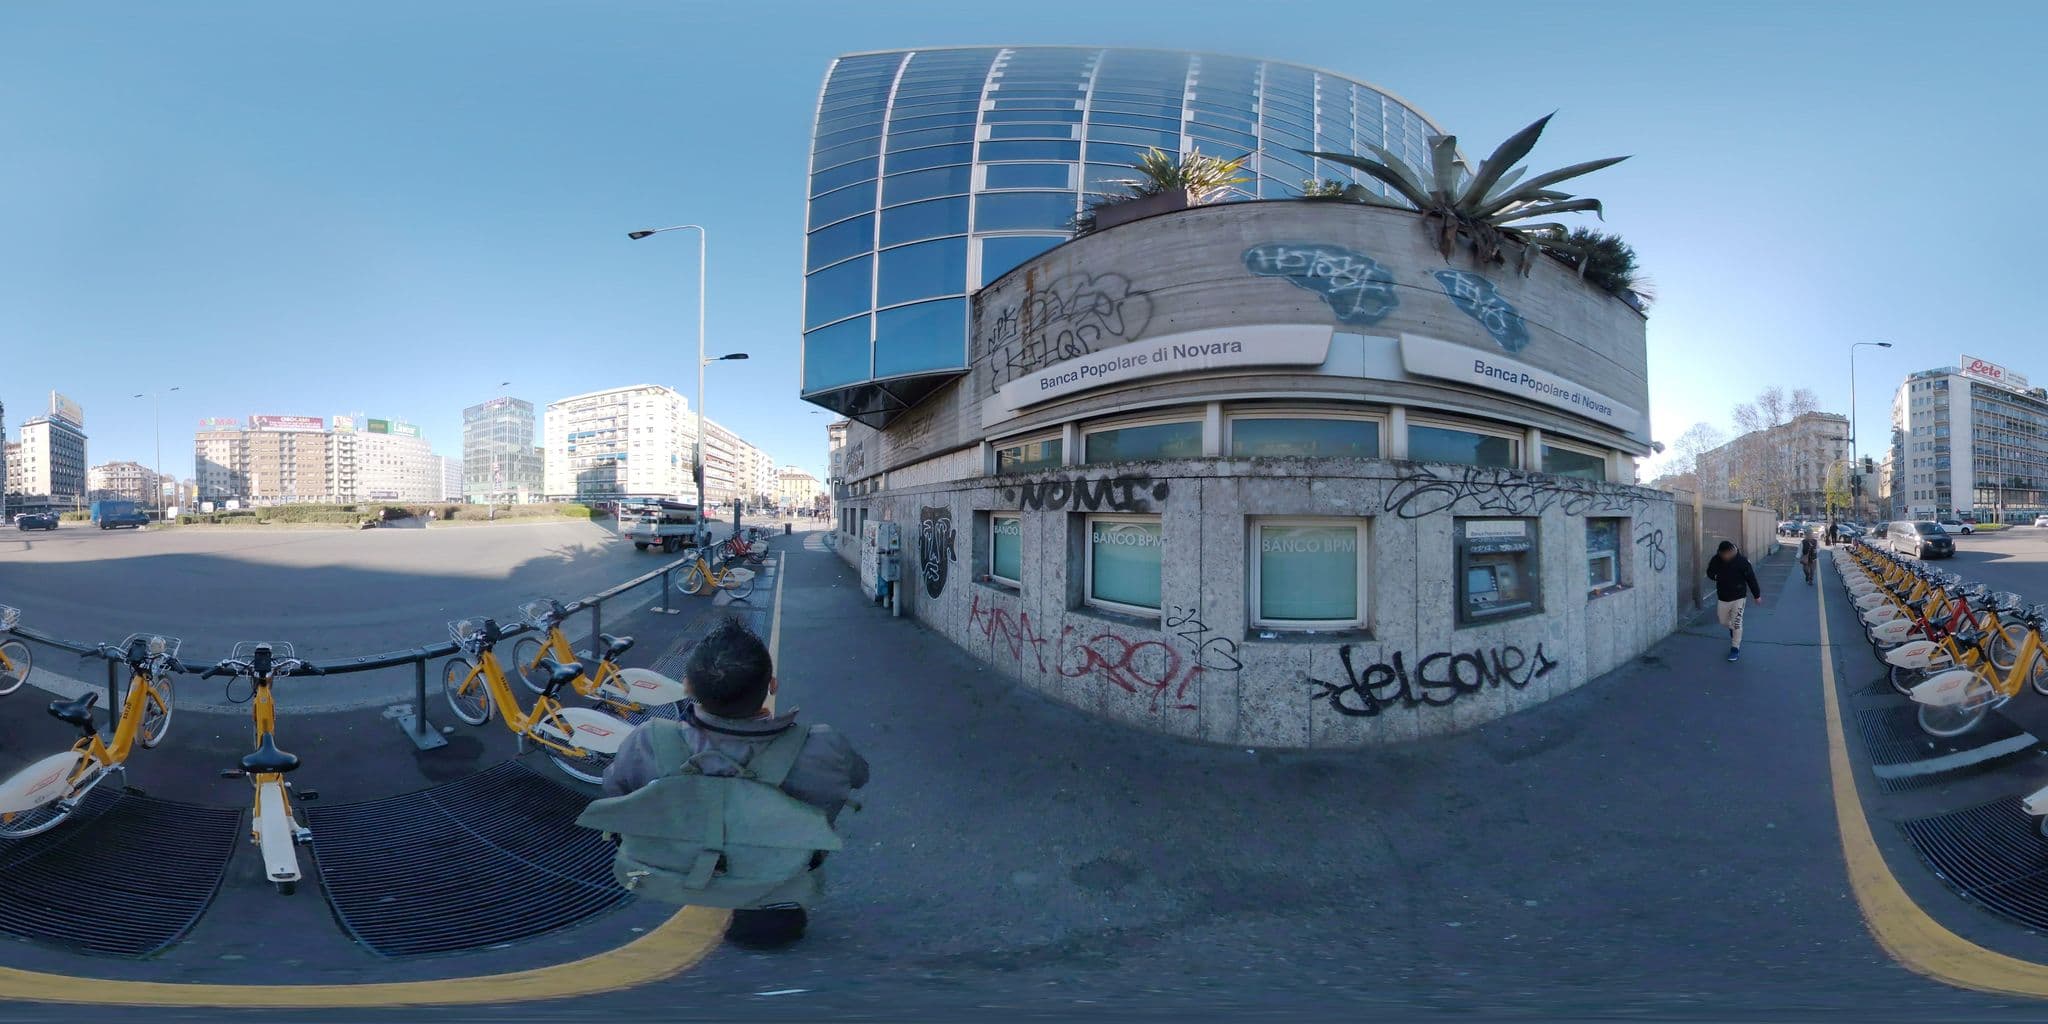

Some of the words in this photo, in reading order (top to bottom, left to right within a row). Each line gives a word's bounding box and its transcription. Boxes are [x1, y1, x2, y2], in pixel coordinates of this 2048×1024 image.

[1040, 370, 1079, 391] Banca
[1080, 353, 1148, 380] Popolare
[1152, 345, 1168, 362] di
[1172, 338, 1243, 359] Novara
[1966, 360, 2001, 378] Lete
[1474, 359, 1518, 384] Banca
[1520, 373, 1569, 400] Popolare
[1571, 391, 1581, 404] di
[1582, 396, 1612, 416] Novara
[994, 524, 1019, 536] BANCO
[1093, 532, 1136, 546] BANCO
[1138, 533, 1164, 546] BPM
[1262, 539, 1321, 553] BANCO
[1324, 539, 1356, 553] BPM
[1636, 529, 1666, 571] 78
